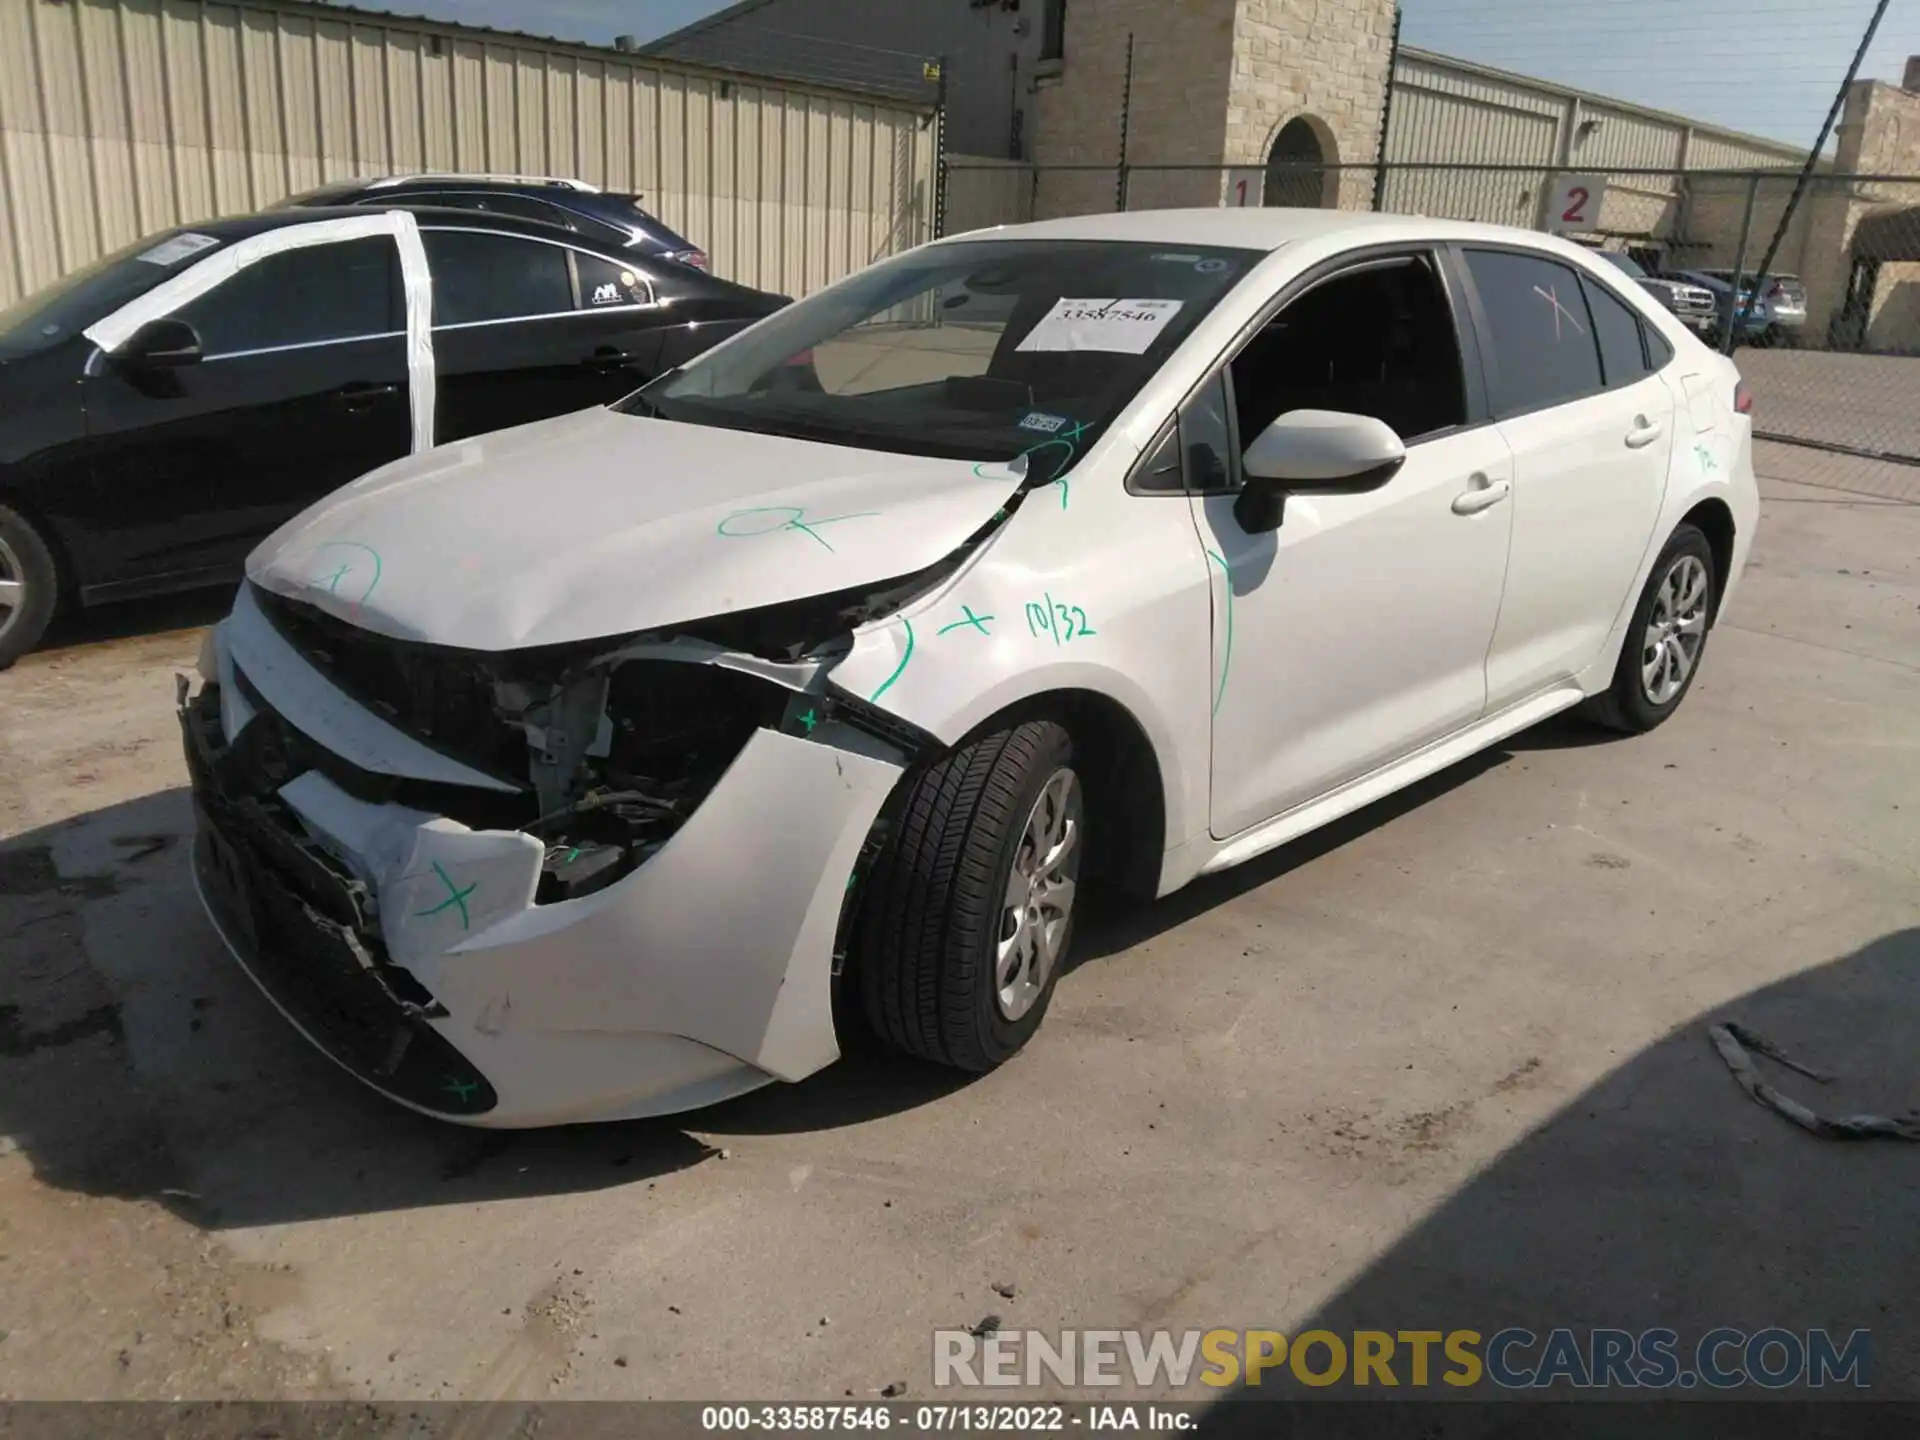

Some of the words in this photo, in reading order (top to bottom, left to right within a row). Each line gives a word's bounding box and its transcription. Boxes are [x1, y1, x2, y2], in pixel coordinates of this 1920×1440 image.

[1236, 180, 1247, 208] 1
[1562, 187, 1589, 222] 2
[1025, 591, 1097, 646] 10/32
